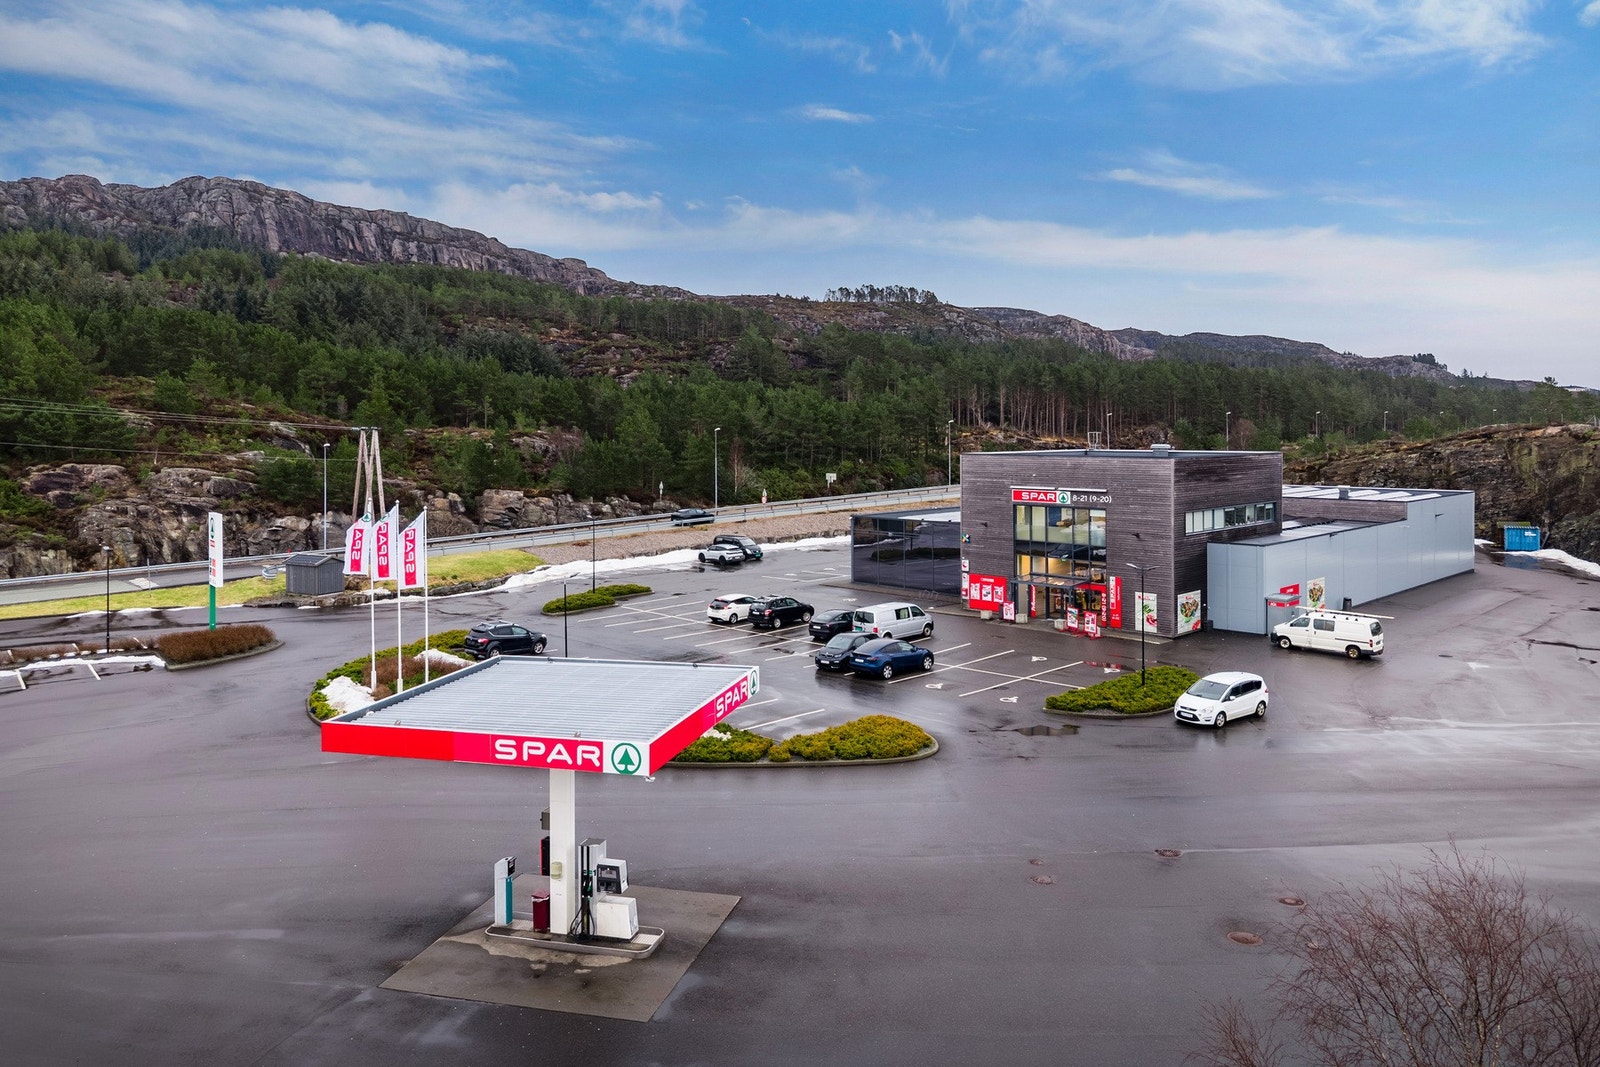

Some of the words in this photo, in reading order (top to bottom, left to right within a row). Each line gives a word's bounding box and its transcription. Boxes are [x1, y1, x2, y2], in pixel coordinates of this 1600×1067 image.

[1021, 492, 1055, 501] SPAR
[1089, 495, 1112, 503] (9-20)
[716, 680, 748, 718] SPAR
[494, 739, 601, 767] SPAR
